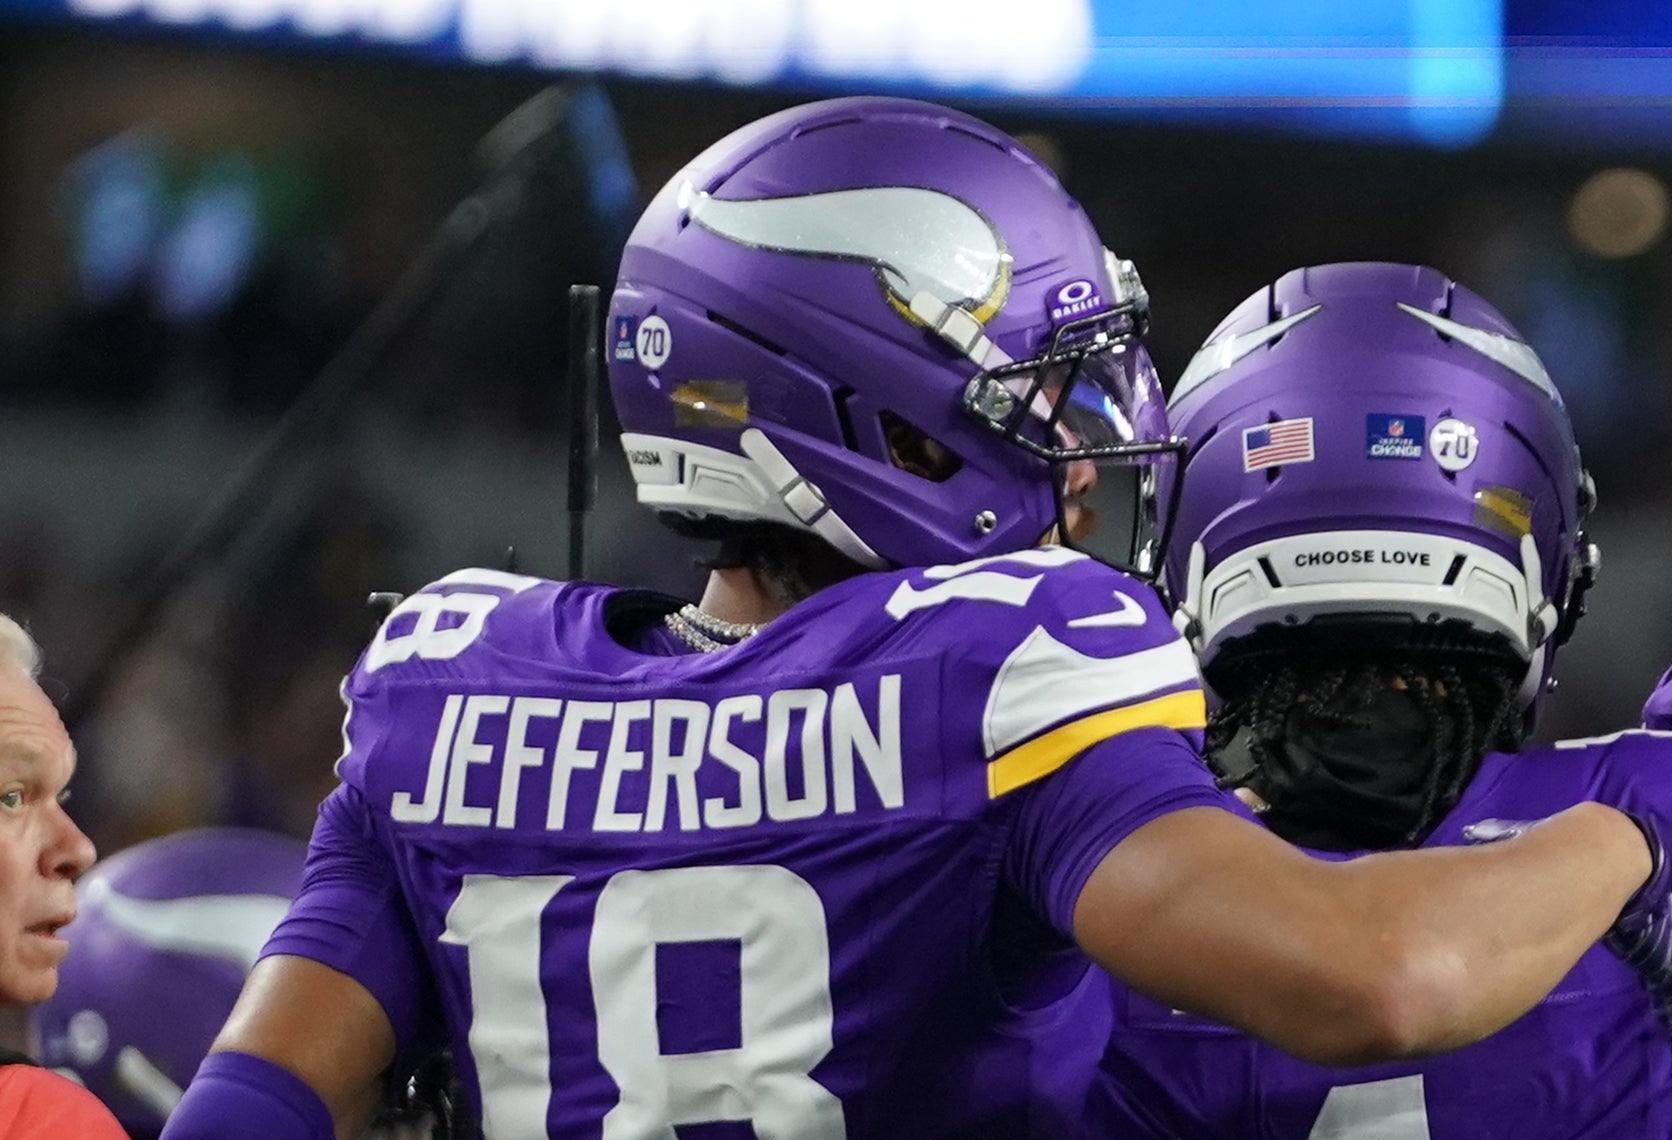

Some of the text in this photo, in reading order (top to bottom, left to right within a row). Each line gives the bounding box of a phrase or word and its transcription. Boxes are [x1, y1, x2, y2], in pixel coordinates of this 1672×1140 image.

[1053, 295, 1100, 319] OAKLEY
[642, 327, 665, 356] 70
[1370, 444, 1422, 458] CHANGE
[1439, 428, 1469, 458] 70
[1295, 550, 1431, 567] CHOOSE LOVE
[390, 674, 904, 832] JEFFERSON
